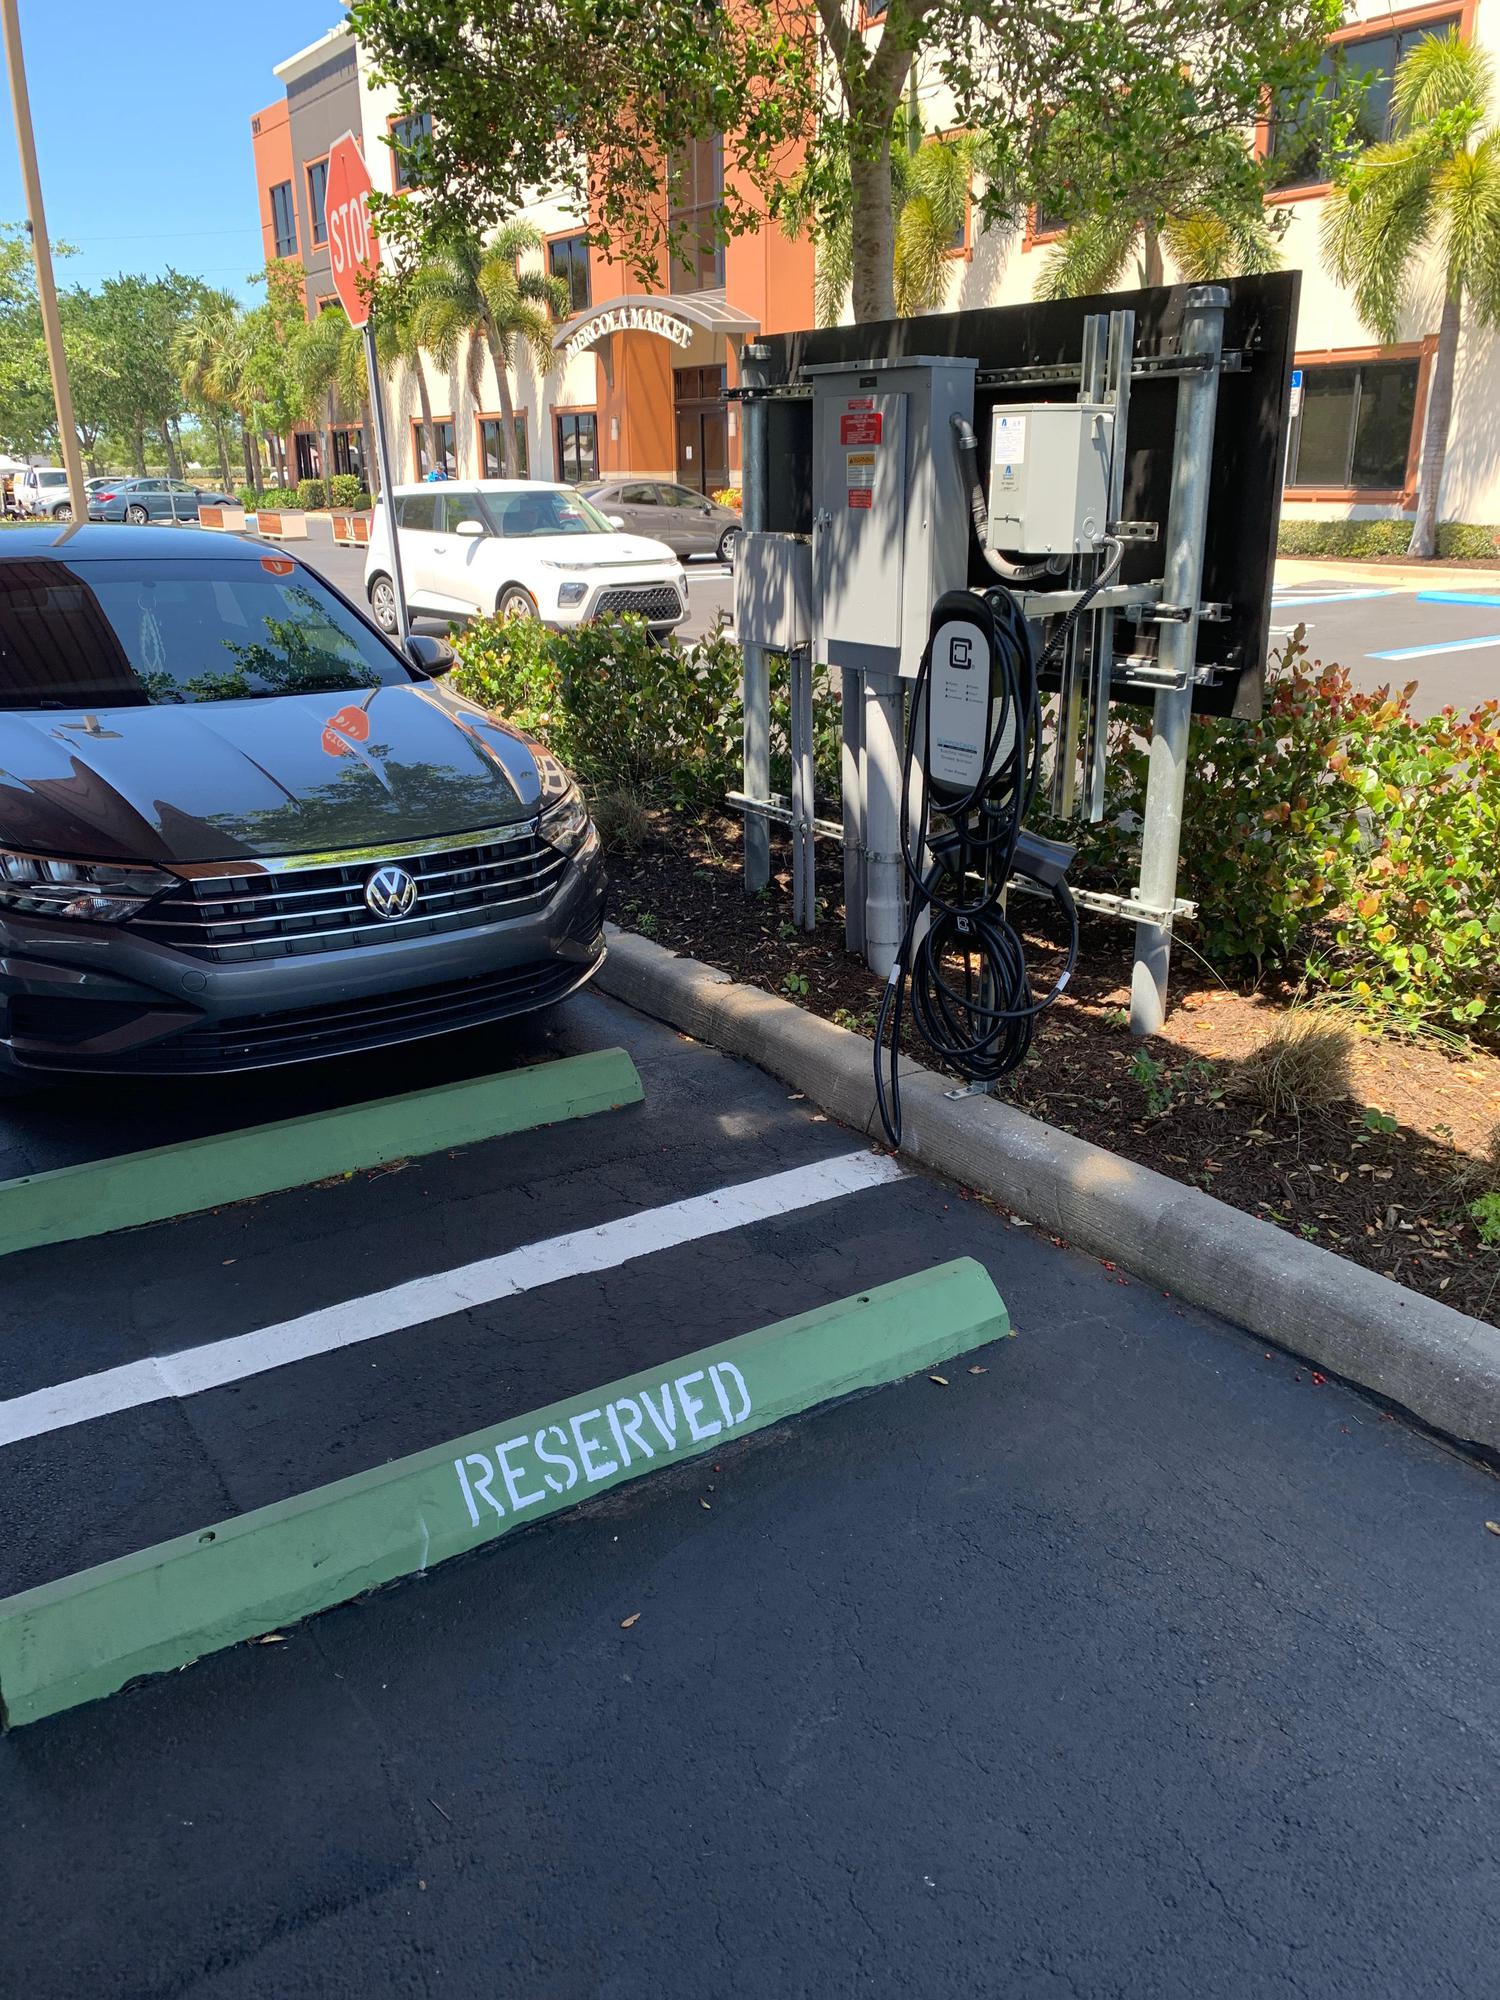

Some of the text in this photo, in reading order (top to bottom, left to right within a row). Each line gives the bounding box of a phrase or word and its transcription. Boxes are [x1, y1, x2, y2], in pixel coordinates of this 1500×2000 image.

[331, 190, 372, 274] STOP
[565, 308, 693, 359] MERCOLA MARKET
[454, 1361, 752, 1528] RESERVED
